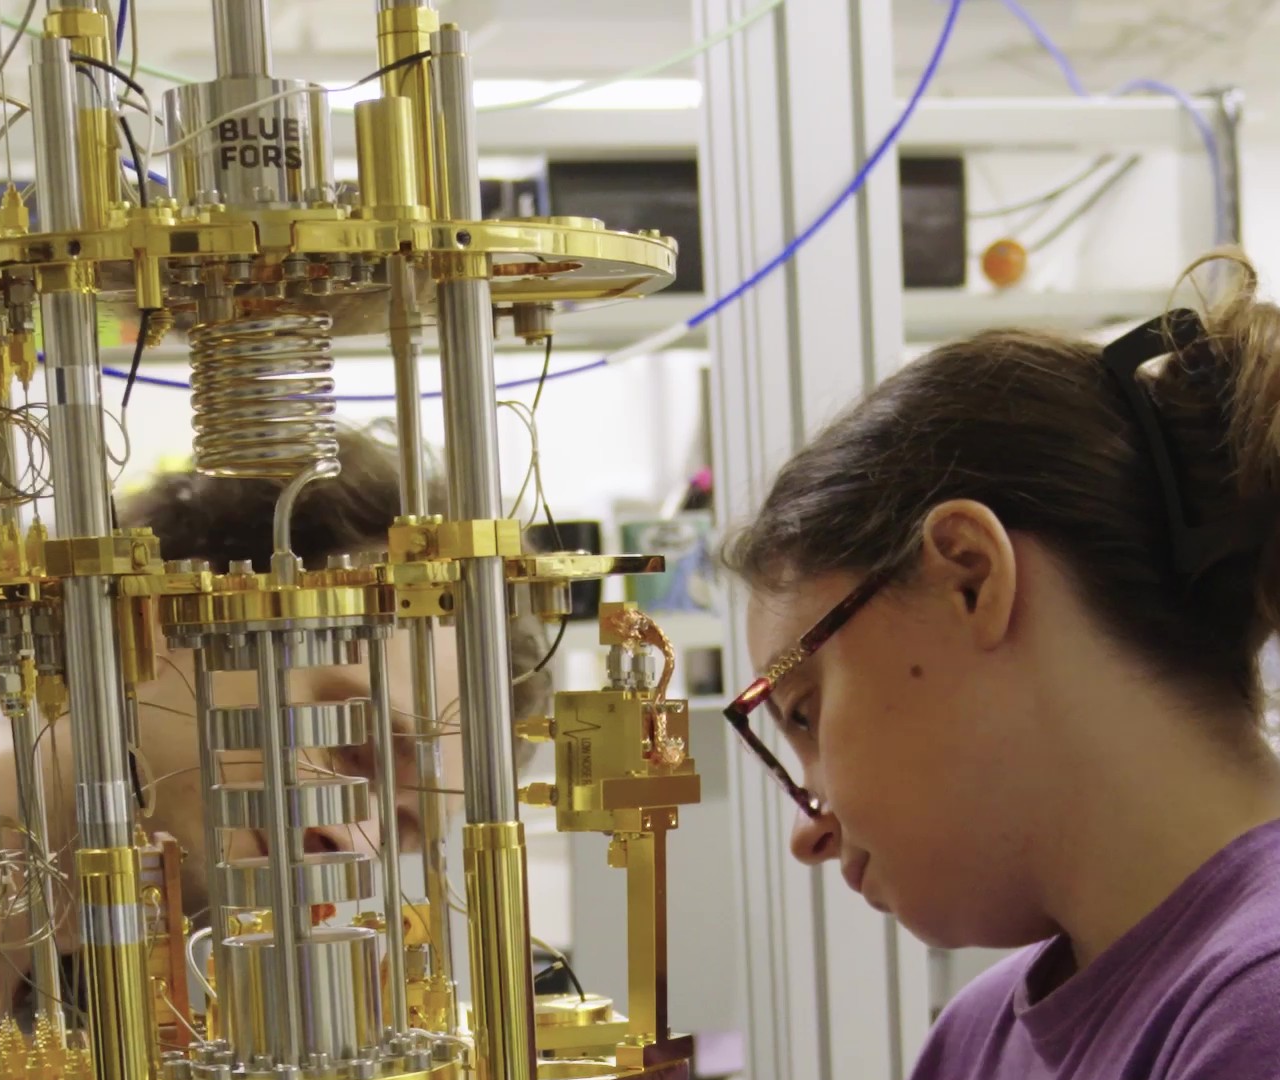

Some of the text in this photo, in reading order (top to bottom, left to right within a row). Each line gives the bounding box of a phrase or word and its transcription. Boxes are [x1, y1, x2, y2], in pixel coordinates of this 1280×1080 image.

[219, 117, 299, 142] BLUE
[221, 144, 302, 170] FORS
[581, 737, 591, 754] LOW
[581, 755, 592, 778] NOISE
